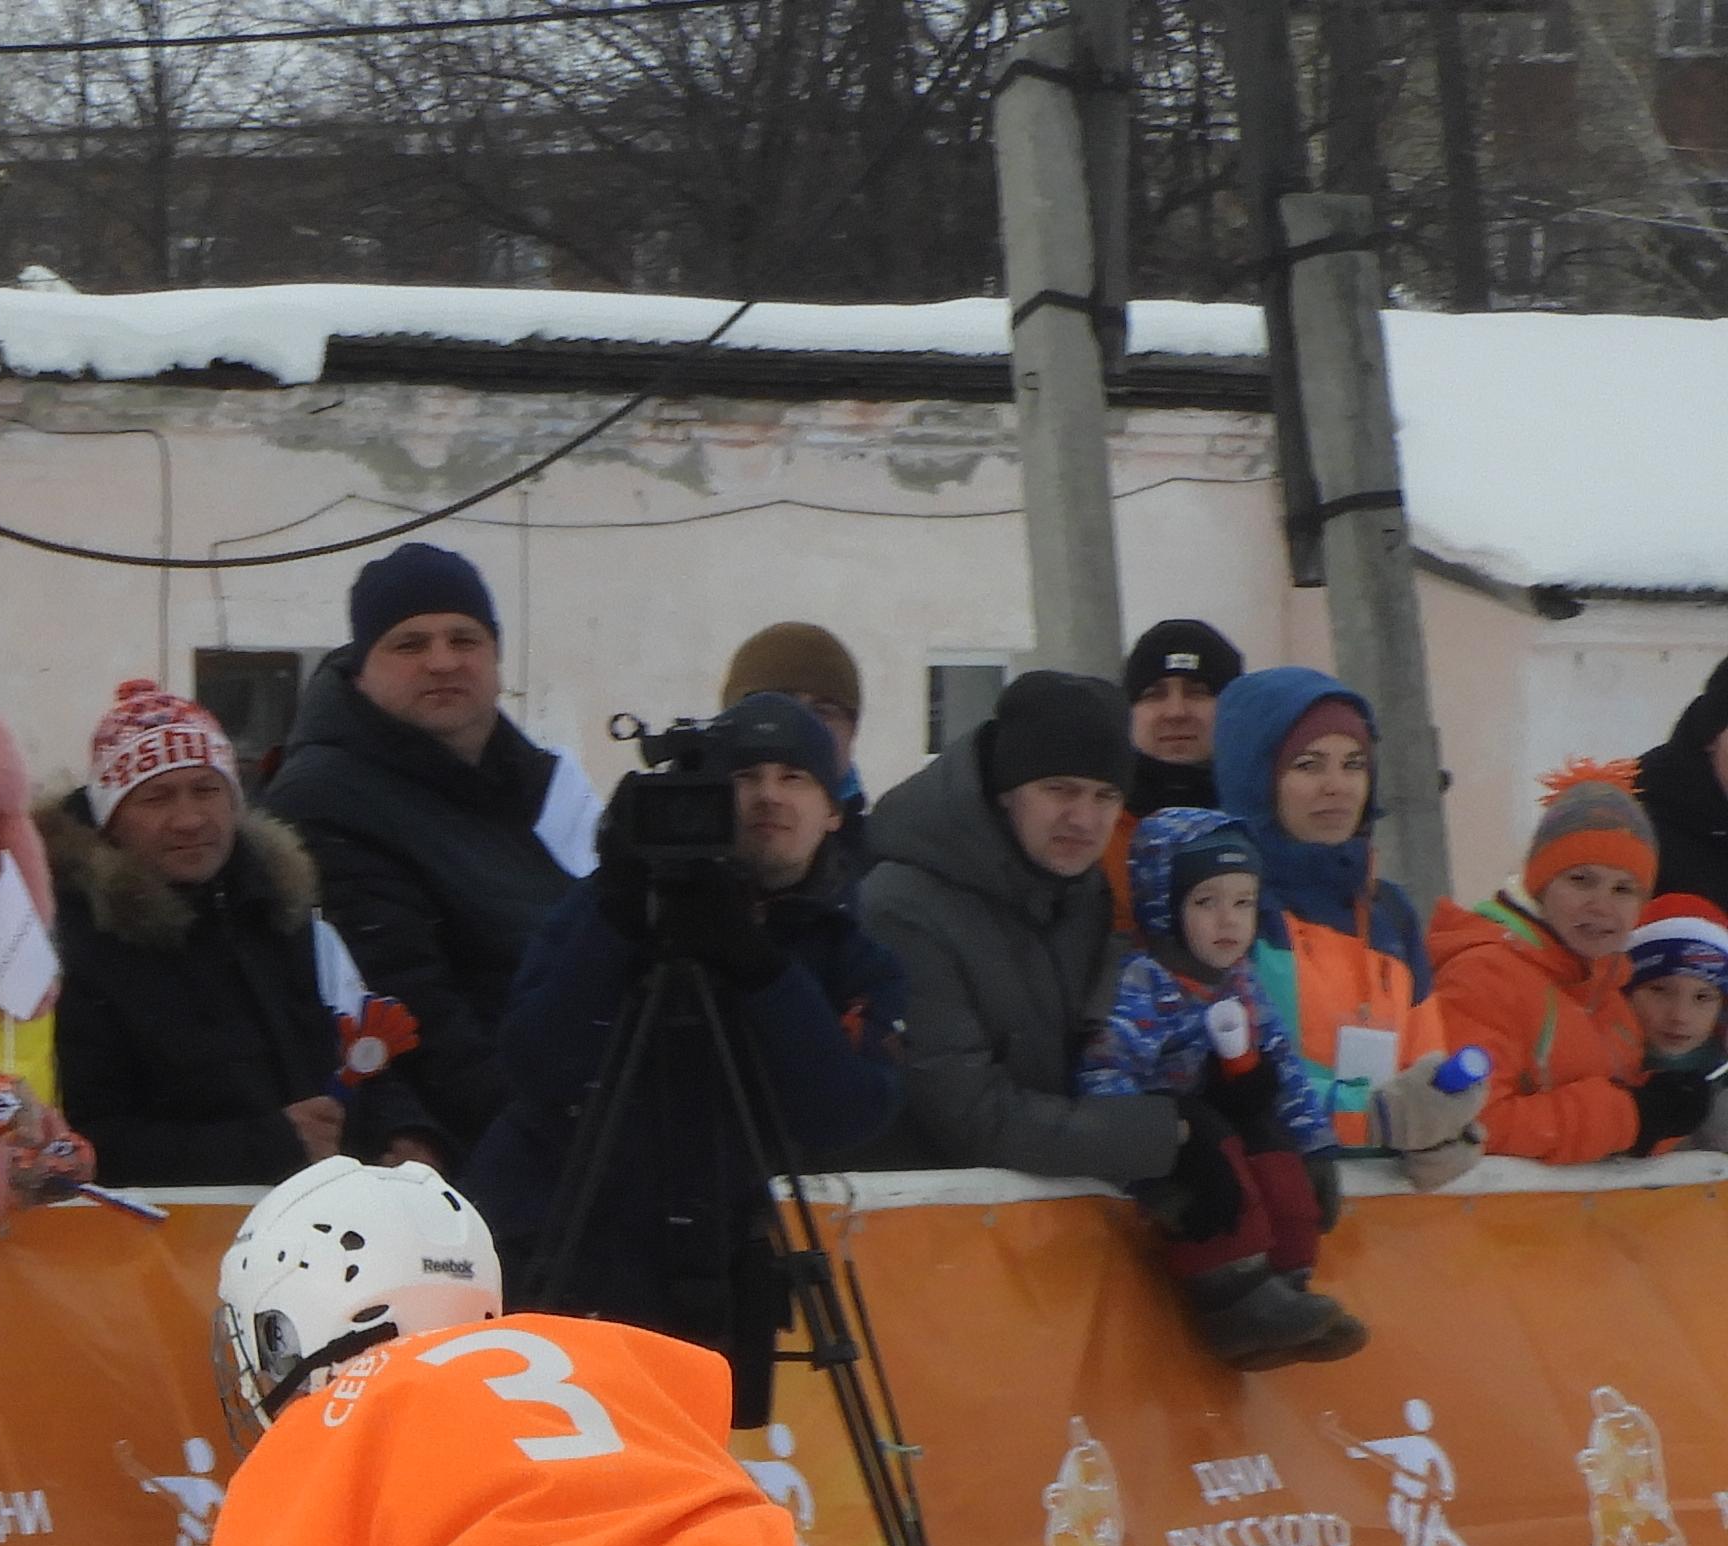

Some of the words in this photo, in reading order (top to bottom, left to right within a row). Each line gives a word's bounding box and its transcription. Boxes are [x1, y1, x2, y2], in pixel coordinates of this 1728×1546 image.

[422, 1256, 475, 1276] Reebok
[414, 1328, 626, 1462] 3
[1191, 1453, 1284, 1506] ДНИ
